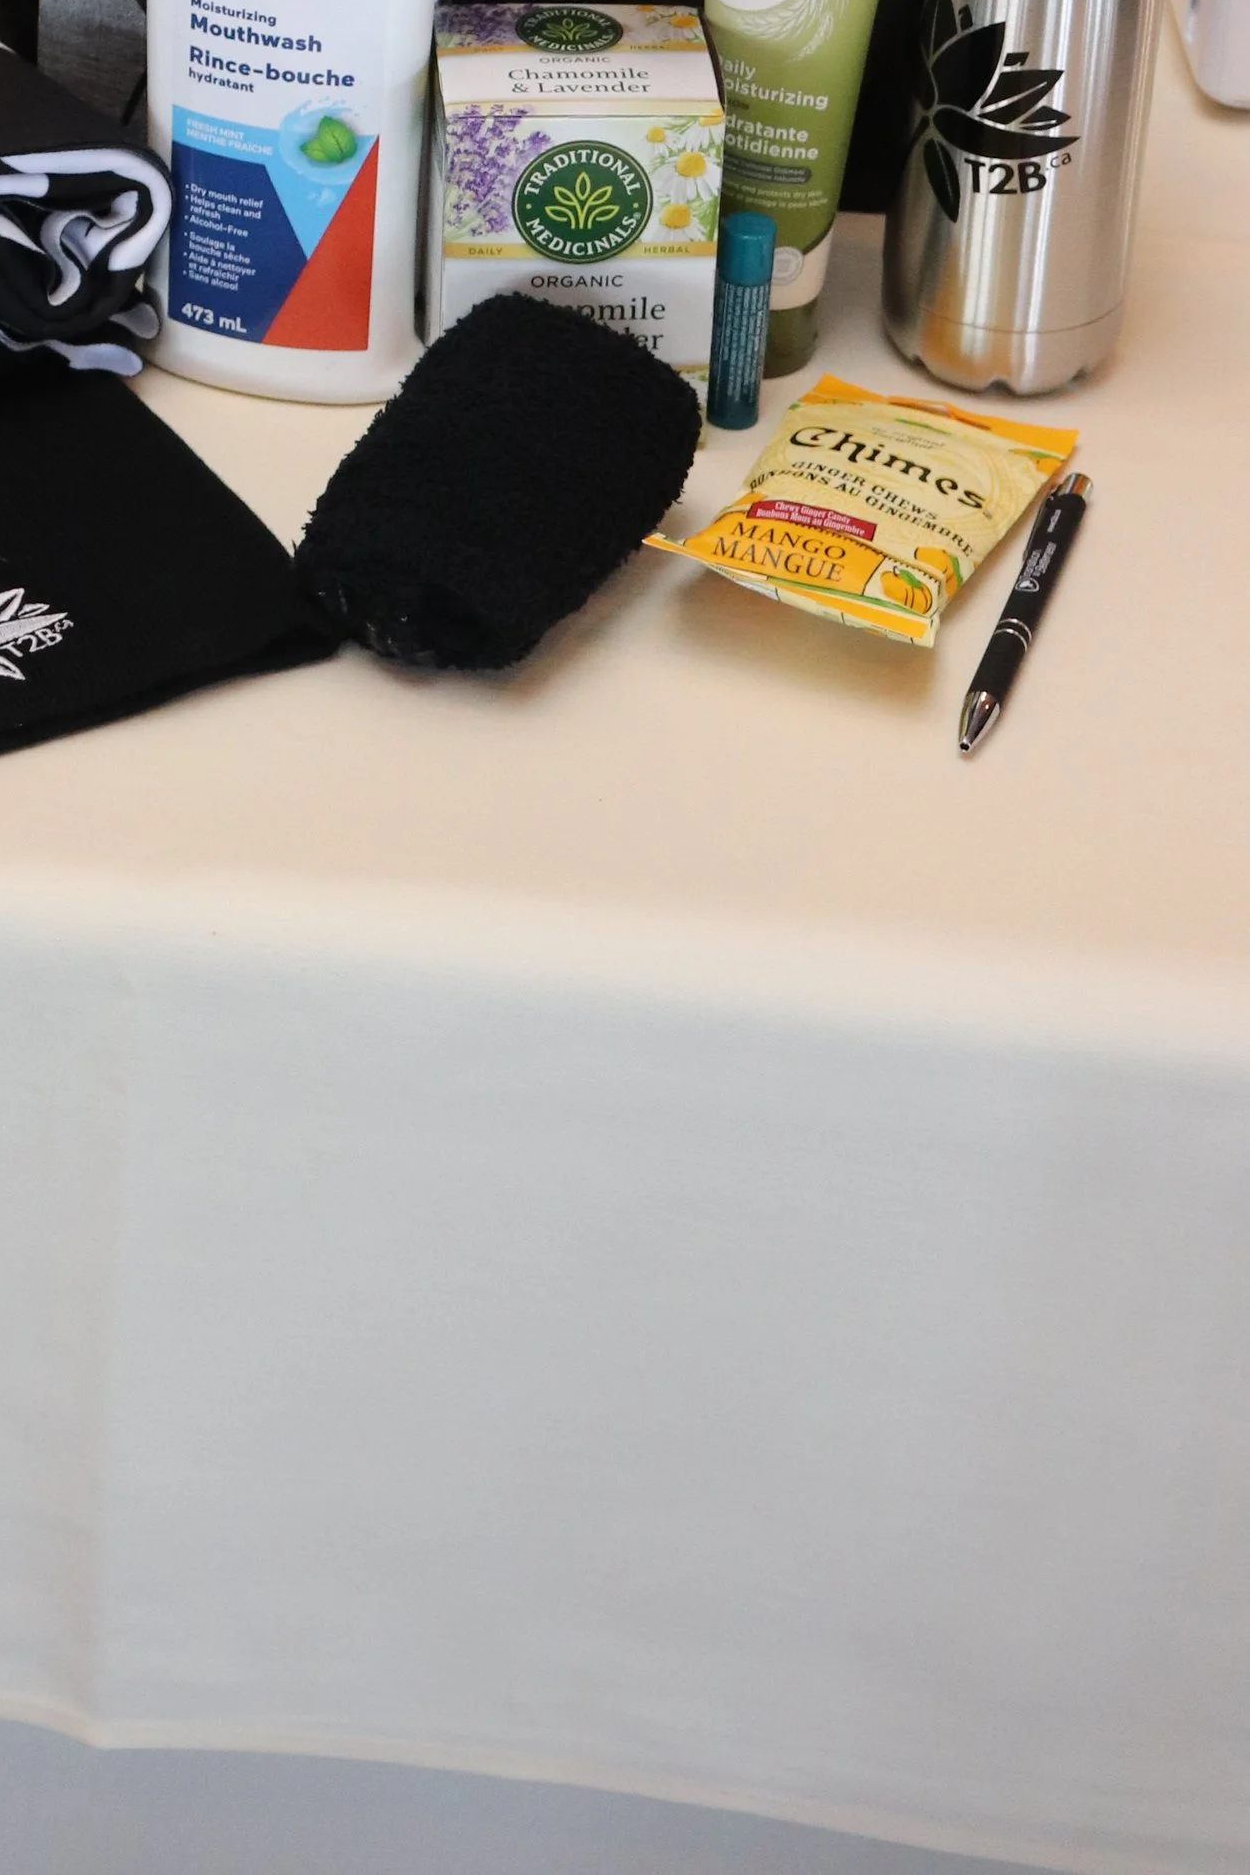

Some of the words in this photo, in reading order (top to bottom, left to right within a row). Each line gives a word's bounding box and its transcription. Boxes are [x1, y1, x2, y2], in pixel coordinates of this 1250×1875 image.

[190, 13, 323, 53] Mouthwash
[527, 33, 617, 52] MEDICINALS
[189, 45, 356, 87] Rince-bouche
[539, 56, 612, 64] ORGANIC
[723, 58, 756, 81] aily
[188, 67, 255, 93] hydratant
[508, 68, 651, 81] Chamomile
[511, 82, 529, 94] &
[538, 81, 652, 94] Lavender
[724, 77, 830, 111] oisturizing
[724, 113, 809, 143] dratante
[724, 132, 820, 161] otidienne
[524, 149, 642, 197] TRADITIONAL
[190, 183, 207, 197] Dry
[208, 190, 238, 204] mouth
[239, 197, 264, 209] relief
[190, 194, 216, 210] Helps
[217, 203, 242, 216] clean
[243, 210, 262, 220] and
[189, 214, 249, 238] Alcohol-Free
[190, 205, 221, 220] refresh
[525, 214, 639, 257] MEDICINALS
[468, 247, 503, 256] DAILY
[643, 245, 691, 255] HERBAL
[530, 275, 624, 288] ORGANIC
[181, 302, 215, 325] 473
[218, 316, 248, 334] mL
[789, 426, 986, 510] Chimes
[791, 460, 867, 488] GINGER
[871, 483, 939, 521] CHEWS
[756, 508, 789, 520] Bonbons
[812, 517, 823, 525] au
[823, 517, 866, 536] Gingembre
[775, 501, 800, 514] Chewy
[800, 505, 827, 519] Ginger
[827, 511, 851, 525] Candy
[834, 482, 863, 498] AU
[865, 495, 975, 557] GINGEMBRE
[730, 522, 846, 560] MANGO
[712, 536, 846, 582] MANGUE
